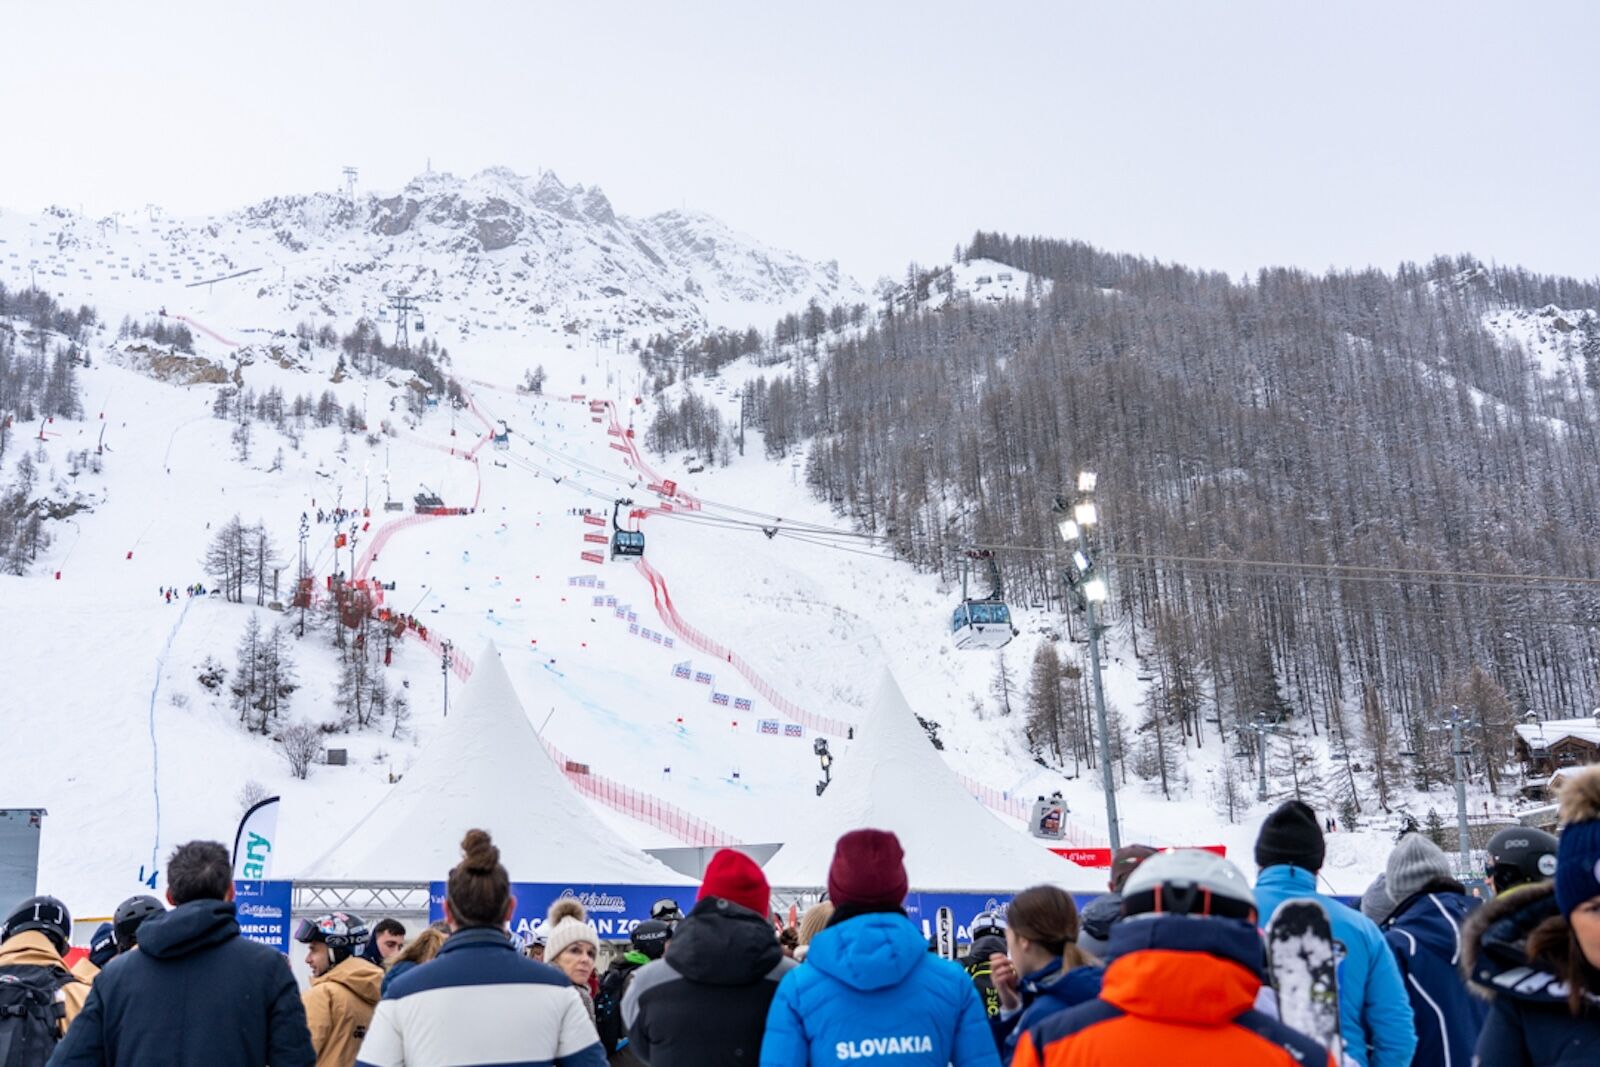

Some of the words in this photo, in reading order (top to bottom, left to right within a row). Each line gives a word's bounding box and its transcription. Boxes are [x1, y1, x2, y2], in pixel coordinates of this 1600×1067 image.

[269, 924, 282, 934] DE
[586, 918, 613, 934] AN
[836, 1035, 932, 1060] SLOVAKIA
